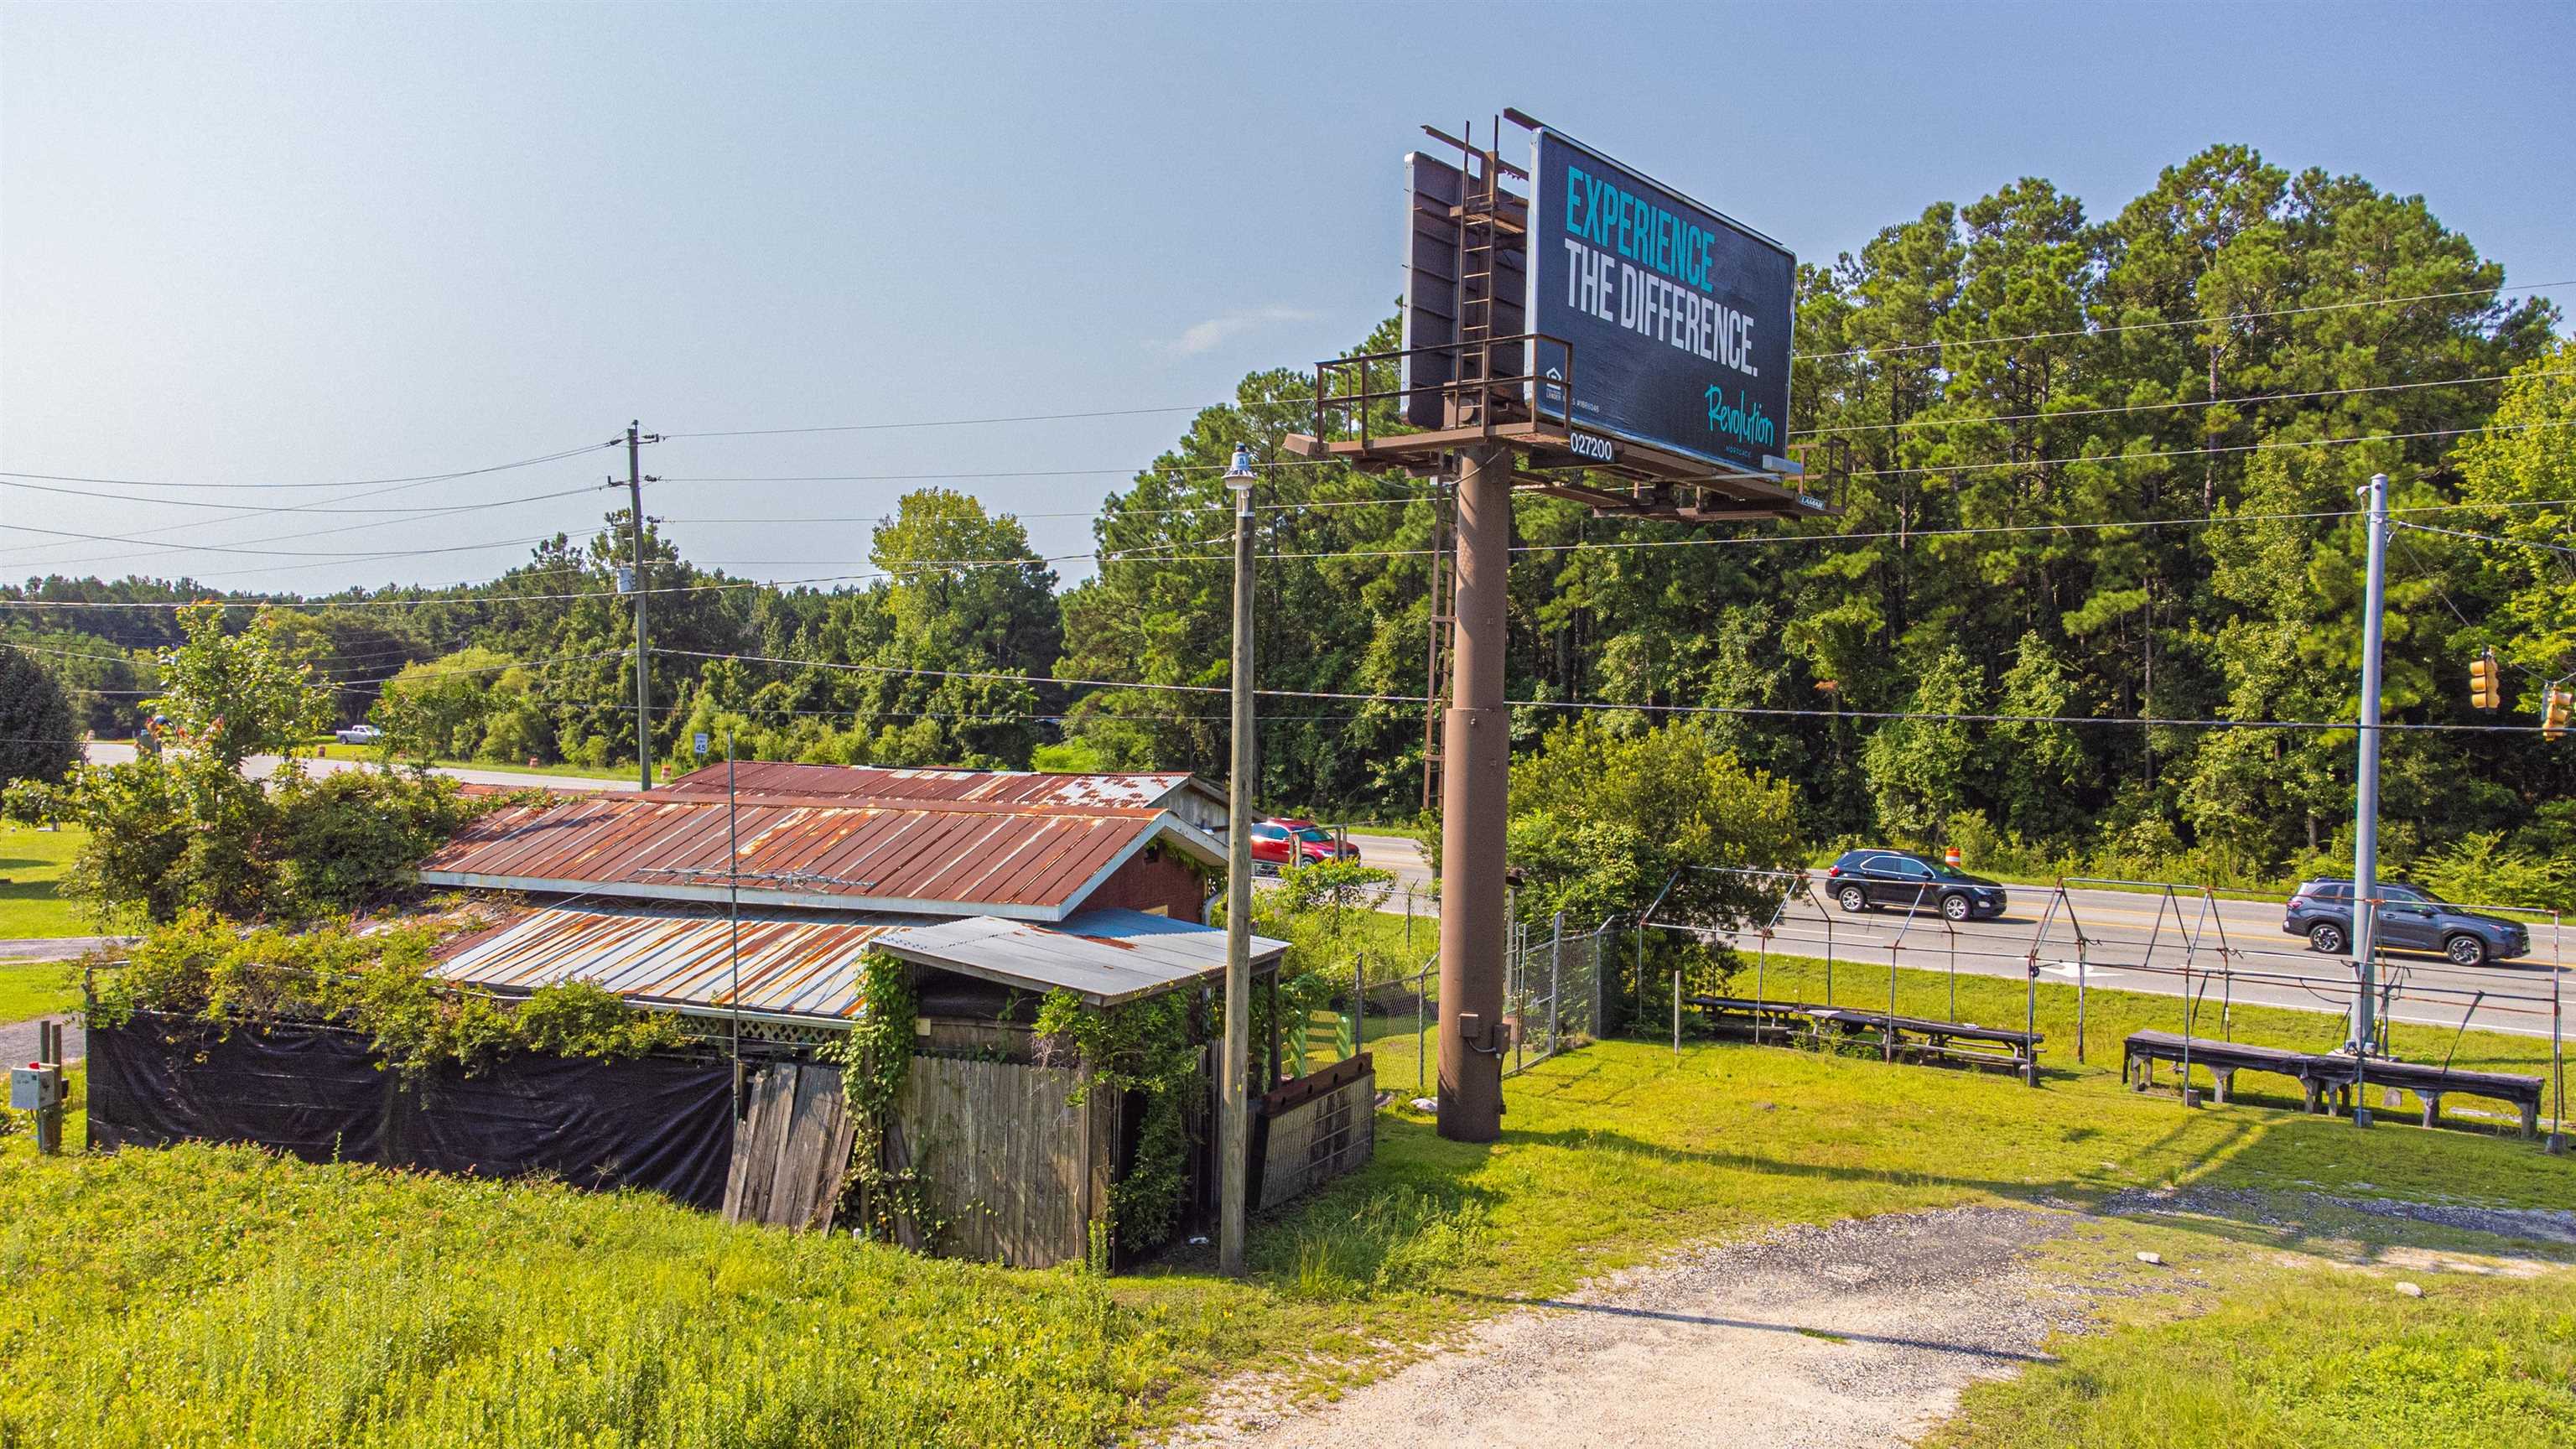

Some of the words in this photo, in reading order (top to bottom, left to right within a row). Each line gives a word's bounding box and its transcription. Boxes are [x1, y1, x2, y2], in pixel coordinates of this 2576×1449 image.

[1566, 166, 1715, 293] EXPERIENCE
[1565, 237, 1615, 322] THE
[1620, 262, 1758, 377] DIFFERENCE.
[1570, 433, 1612, 460] 027200
[1705, 384, 1774, 447] Revolution
